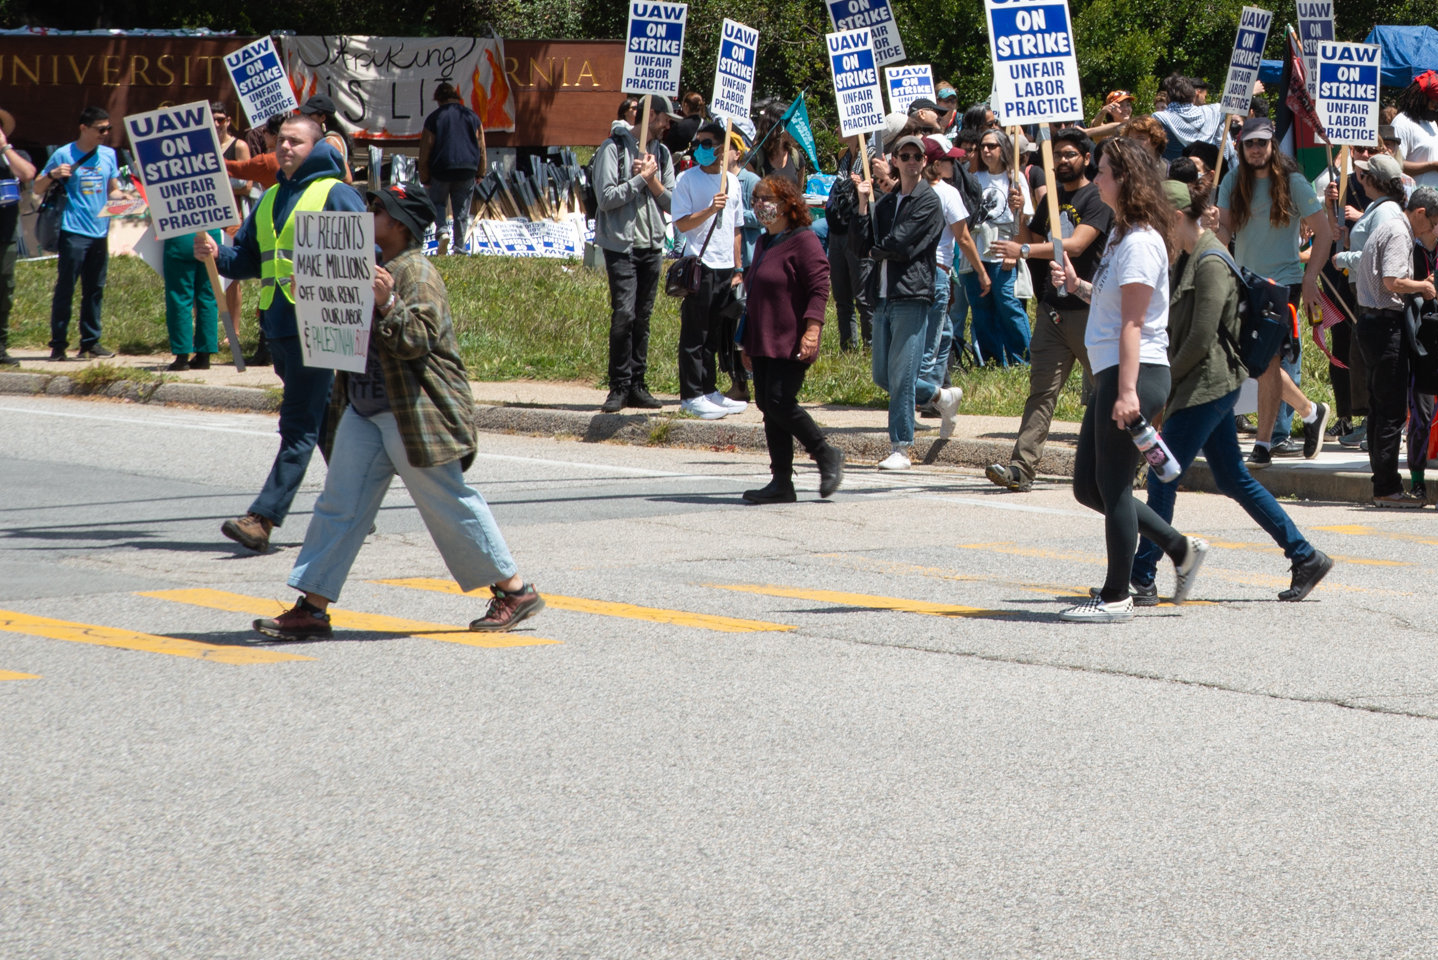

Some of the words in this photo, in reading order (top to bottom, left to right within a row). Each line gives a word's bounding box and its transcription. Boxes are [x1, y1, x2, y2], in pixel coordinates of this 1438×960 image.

[633, 4, 684, 20] UAW
[837, 7, 889, 31] STRIKE
[1298, 3, 1331, 18] UAW
[1016, 9, 1046, 31] ON
[1242, 10, 1270, 29] UAW
[646, 23, 666, 37] ON
[725, 23, 756, 46] UAW
[871, 25, 888, 38] AIR
[1310, 23, 1322, 37] ON
[630, 37, 679, 54] STRIKE
[829, 32, 868, 52] UAW
[998, 32, 1069, 57] STRIKE
[1242, 33, 1255, 48] ON
[227, 39, 268, 67] UAW
[732, 46, 745, 61] ON
[1233, 49, 1260, 67] STRIKE
[1322, 46, 1378, 62] UAW
[0, 55, 223, 86] NIVERSIT
[246, 60, 264, 76] ON
[635, 56, 672, 68] UNFAIR
[720, 58, 752, 80] STRIKE
[843, 54, 859, 70] ON
[1010, 61, 1065, 79] UNFAIR
[239, 66, 281, 93] STRIKE
[635, 67, 668, 79] LABOR
[837, 69, 875, 89] STRIKE
[889, 68, 928, 77] UAW
[1231, 70, 1251, 84] UNFAIR
[1337, 67, 1360, 81] ON
[626, 78, 676, 91] PRACTICE
[722, 76, 746, 93] UNFAIR
[892, 85, 931, 96] STRIKE
[902, 78, 919, 86] ON
[1015, 80, 1064, 98] LABOR
[1228, 83, 1247, 96] LABOR
[1321, 82, 1375, 99] STRIKE
[249, 82, 281, 102] UNFAIR
[722, 89, 744, 105] LABOR
[843, 89, 873, 104] UNFAIR
[251, 97, 294, 123] PRACTICE
[254, 92, 283, 111] LABOR
[715, 98, 748, 118] PRACTICE
[846, 102, 873, 117] LABOR
[1005, 97, 1078, 117] PRACTICE
[1222, 96, 1249, 110] PRACTICE
[1327, 102, 1368, 115] UNFAIR
[130, 107, 204, 138] UAW
[843, 113, 883, 131] PRACTICE
[1329, 115, 1366, 127] LABOR
[162, 136, 191, 156] ON
[145, 152, 218, 180] STRIKE
[160, 178, 216, 199] UNFAIR
[166, 194, 217, 214] LABOR
[159, 206, 233, 232] PRACTICE
[297, 215, 314, 247] UC
[318, 215, 364, 250] REGENTS
[297, 254, 323, 277] MAKE
[326, 254, 370, 280] MILLIONS
[299, 285, 315, 300] OFF
[319, 286, 337, 303] OUR
[322, 308, 341, 325] OUR
